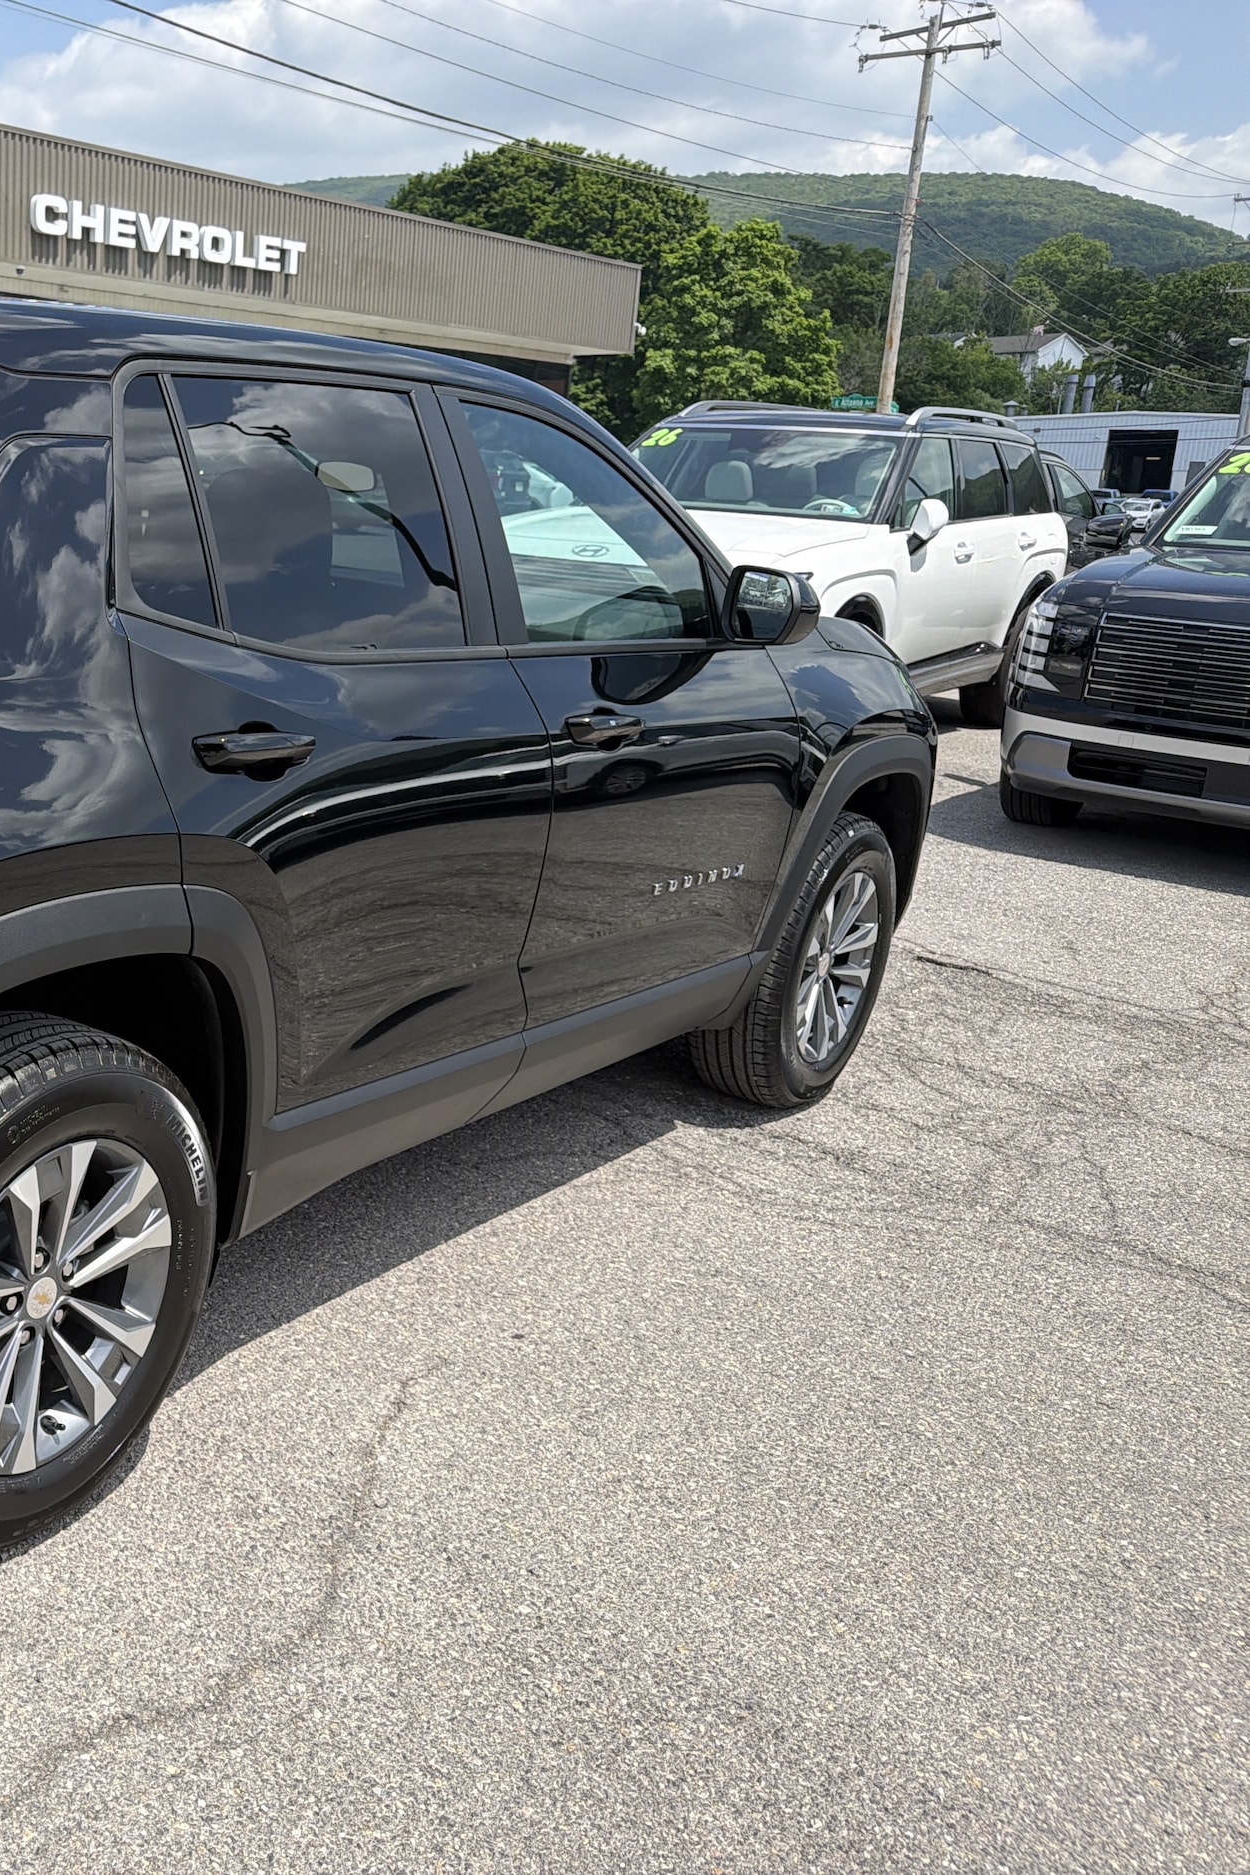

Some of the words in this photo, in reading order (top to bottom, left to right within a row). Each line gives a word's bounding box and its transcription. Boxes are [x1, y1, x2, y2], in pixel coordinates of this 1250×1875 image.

[30, 193, 306, 275] CHEVROLET
[641, 428, 684, 446] 26
[166, 1113, 209, 1202] MICHELIN
